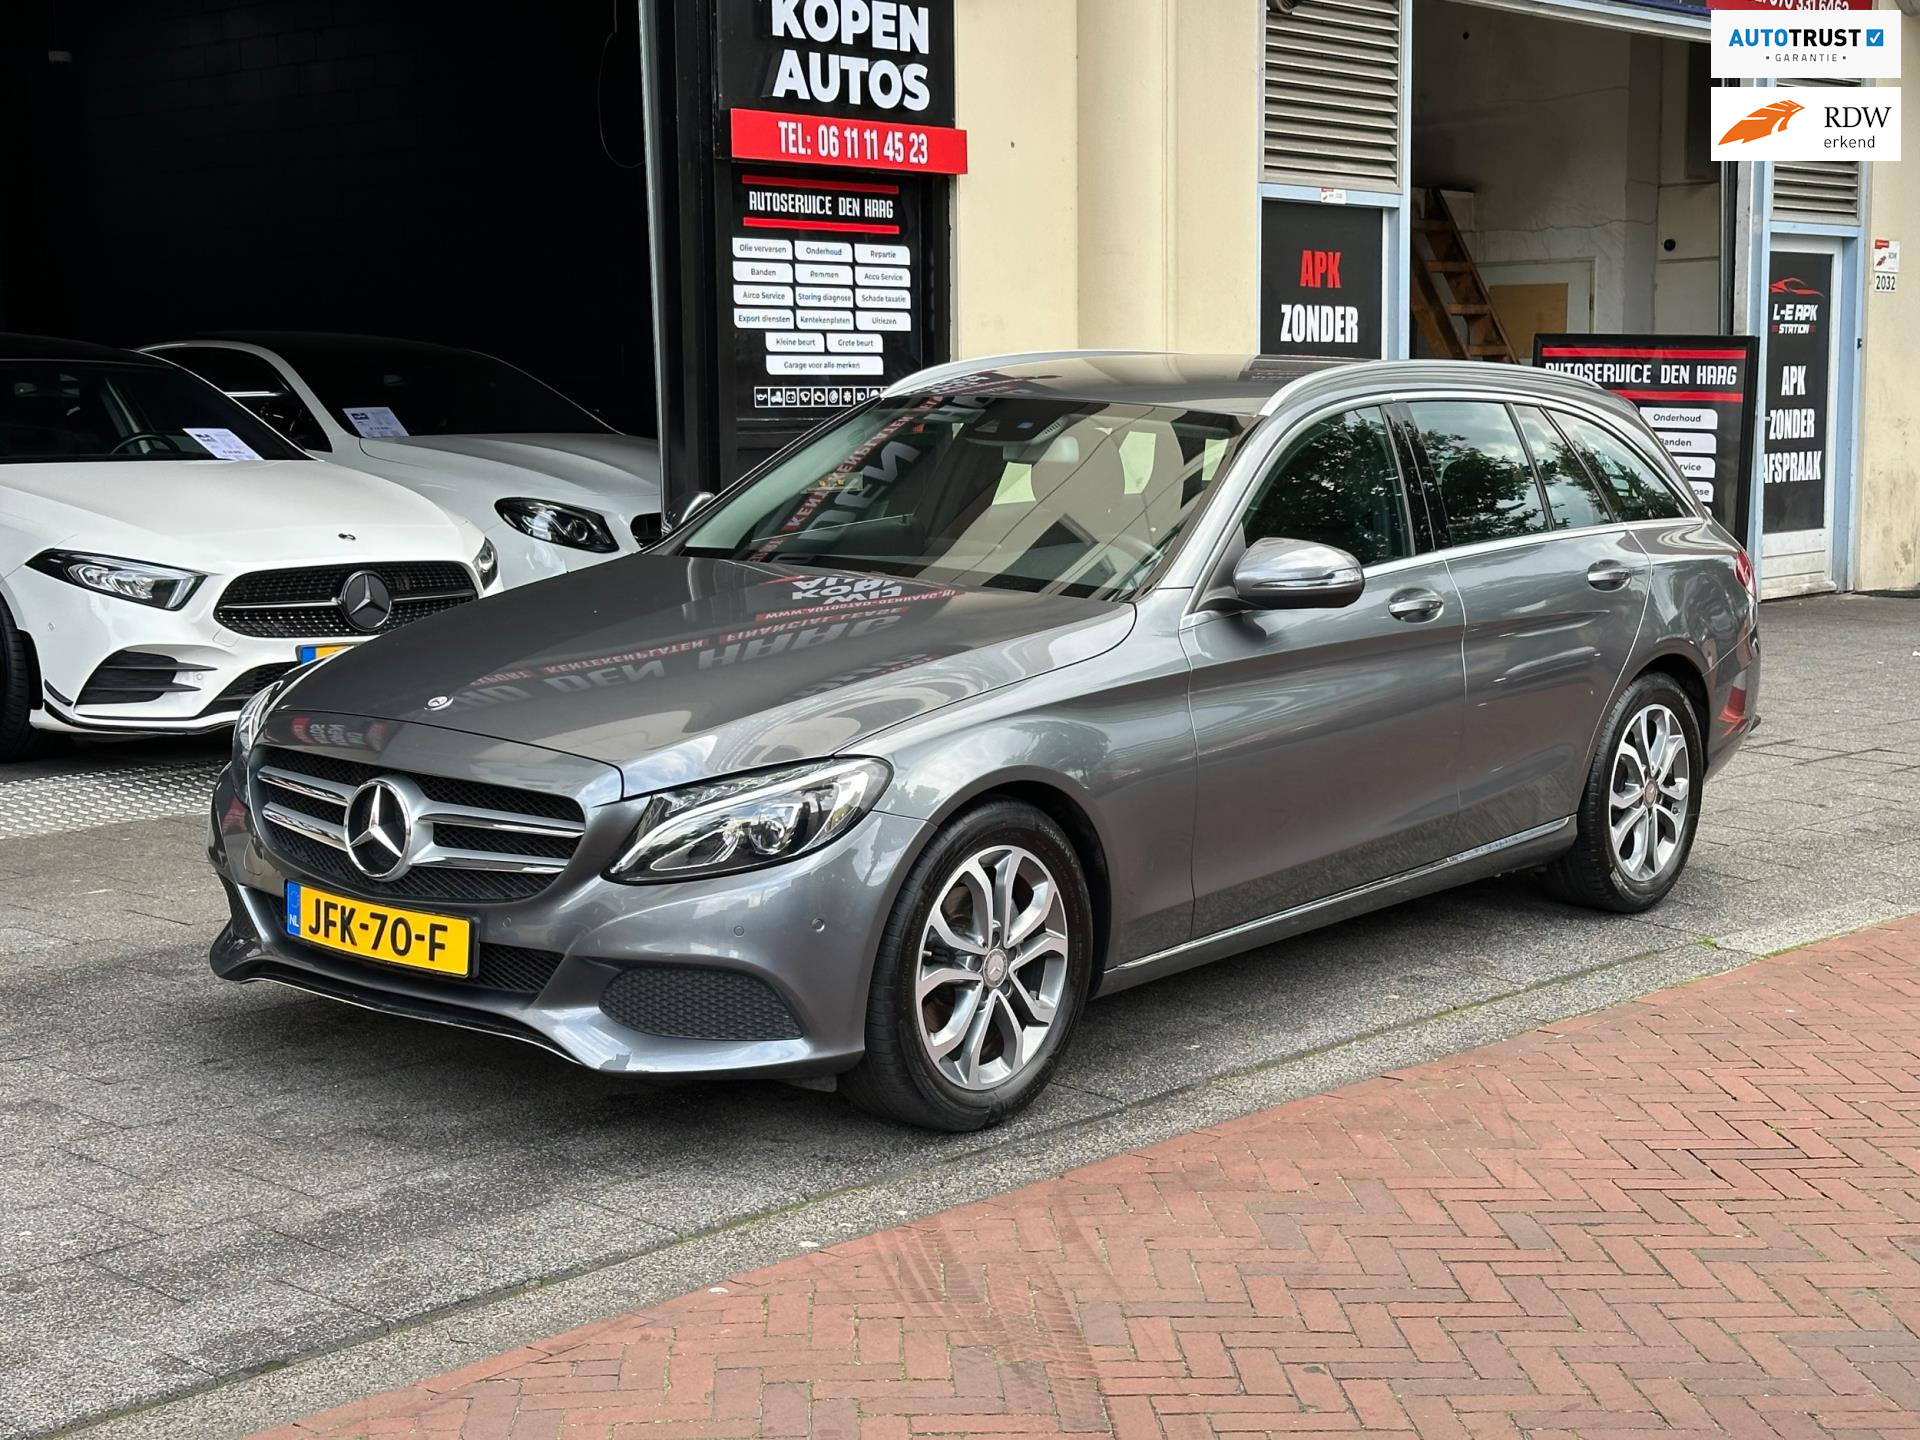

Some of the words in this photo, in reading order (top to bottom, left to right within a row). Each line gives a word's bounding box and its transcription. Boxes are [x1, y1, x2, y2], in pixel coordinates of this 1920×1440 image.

[772, 0, 929, 54] KOPEN
[772, 49, 931, 111] AUTOS
[778, 121, 811, 155] TEL:
[818, 124, 839, 158] 06
[844, 128, 859, 160] 11
[864, 129, 878, 161] 11
[884, 131, 904, 163] 45
[909, 133, 928, 165] 23
[749, 191, 832, 215] AUTOSERVICE
[838, 197, 860, 217] DEN
[864, 199, 894, 218] HAAG
[806, 247, 842, 256] Onderhoud
[751, 268, 777, 276] Banden
[1300, 250, 1341, 288] APK
[810, 271, 839, 279] Remmen
[864, 273, 880, 281] Accu
[881, 273, 903, 281] Service
[1876, 275, 1895, 290] 2032
[743, 291, 760, 299] Airco
[761, 291, 785, 300] Service
[798, 293, 821, 302] Storing
[822, 294, 851, 302] diagnose
[861, 294, 884, 302] Schade
[1773, 304, 1794, 320] L-E
[1795, 304, 1818, 321] APK
[739, 314, 760, 323] Export
[762, 314, 790, 322] diensten
[800, 315, 850, 324] Kentekenplaten
[1280, 304, 1359, 343] ZONDER
[1779, 323, 1810, 334] STATION
[776, 338, 797, 346] Kleine
[798, 338, 816, 346] beurt
[784, 361, 807, 369] Garage
[1661, 365, 1689, 384] DEN
[1696, 366, 1737, 385] HAAG
[1781, 365, 1806, 396] APK
[1653, 414, 1701, 423] Onderhoud
[1769, 409, 1815, 440] ZONDER
[1680, 463, 1701, 471] rvice
[289, 913, 299, 928] NL
[308, 898, 448, 962] JFK-70-F
